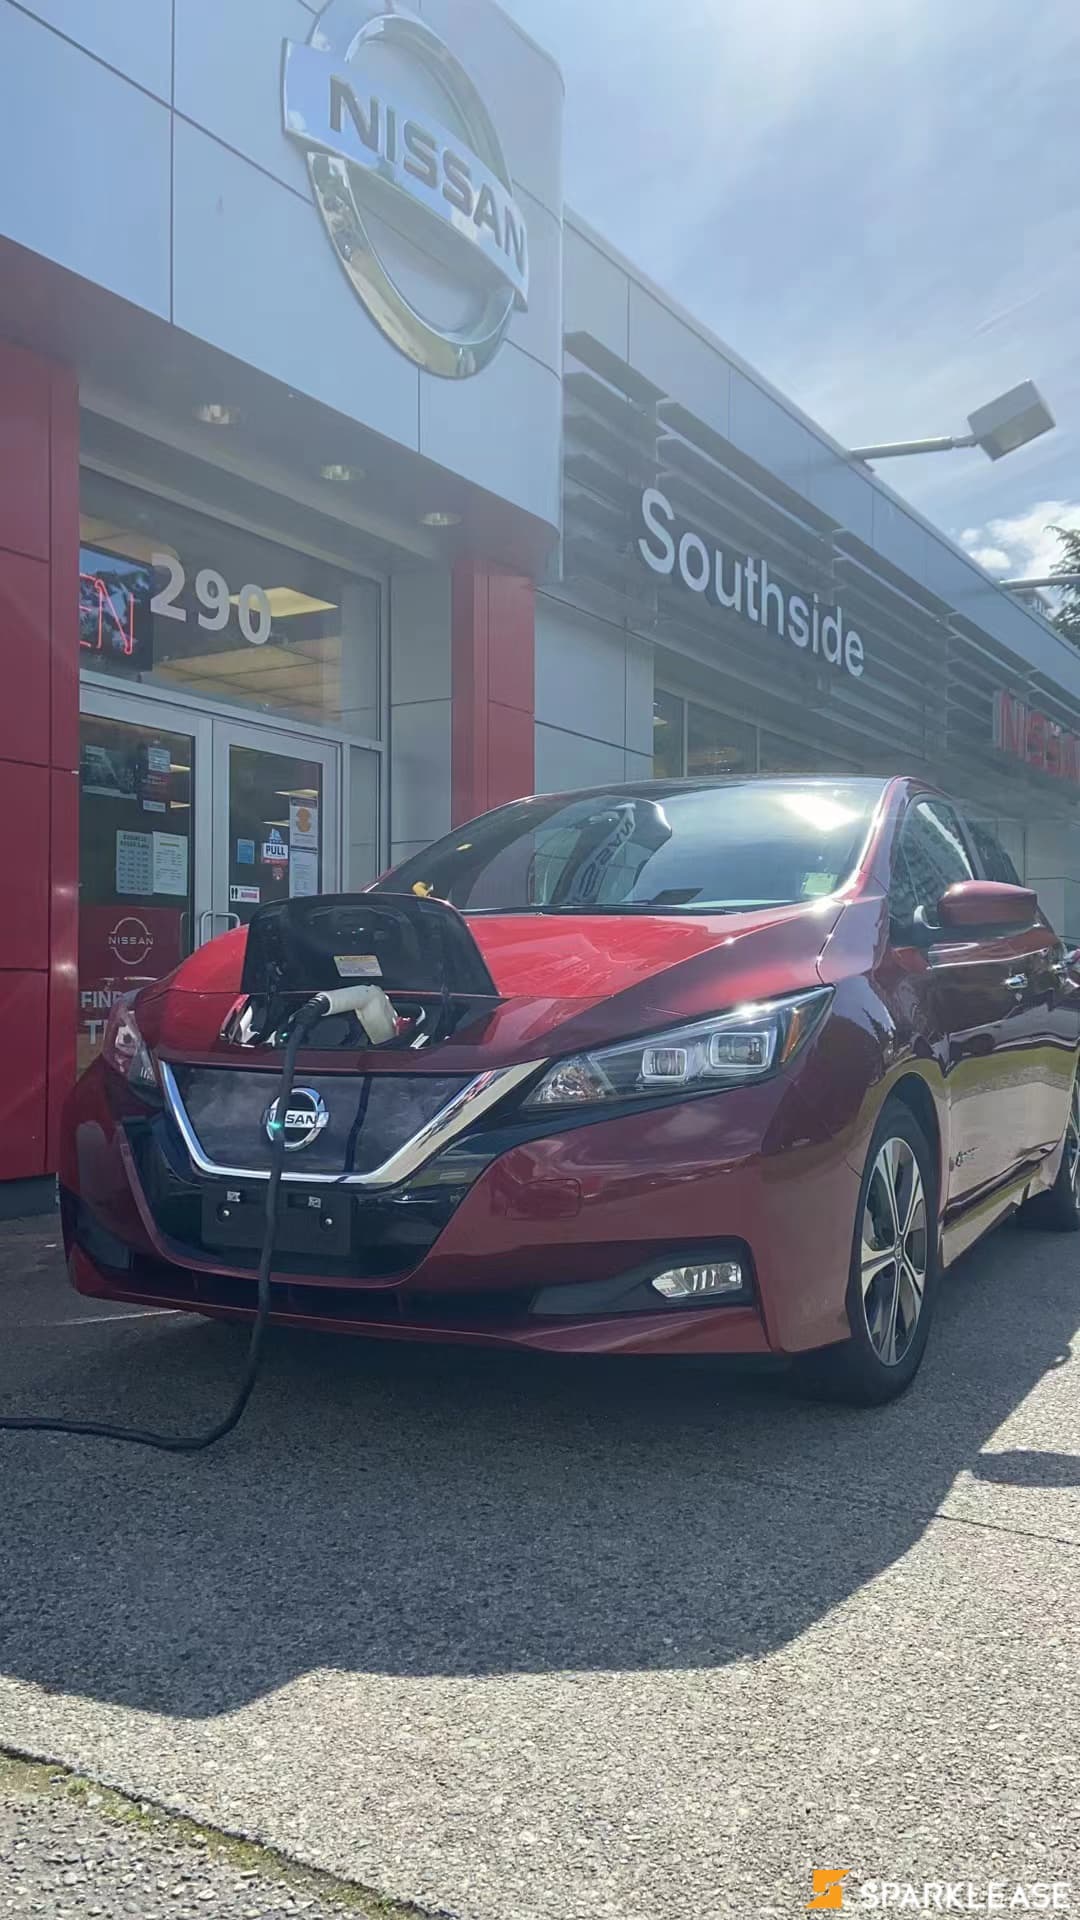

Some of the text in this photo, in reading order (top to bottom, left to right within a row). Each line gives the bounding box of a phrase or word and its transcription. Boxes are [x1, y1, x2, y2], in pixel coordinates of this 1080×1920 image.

[329, 74, 525, 279] NISSAN
[638, 487, 864, 677] Southside
[150, 552, 272, 646] 290
[265, 845, 286, 856] PULL
[108, 935, 154, 945] NISSAN
[84, 1019, 109, 1045] T
[266, 1110, 317, 1125] NSAN
